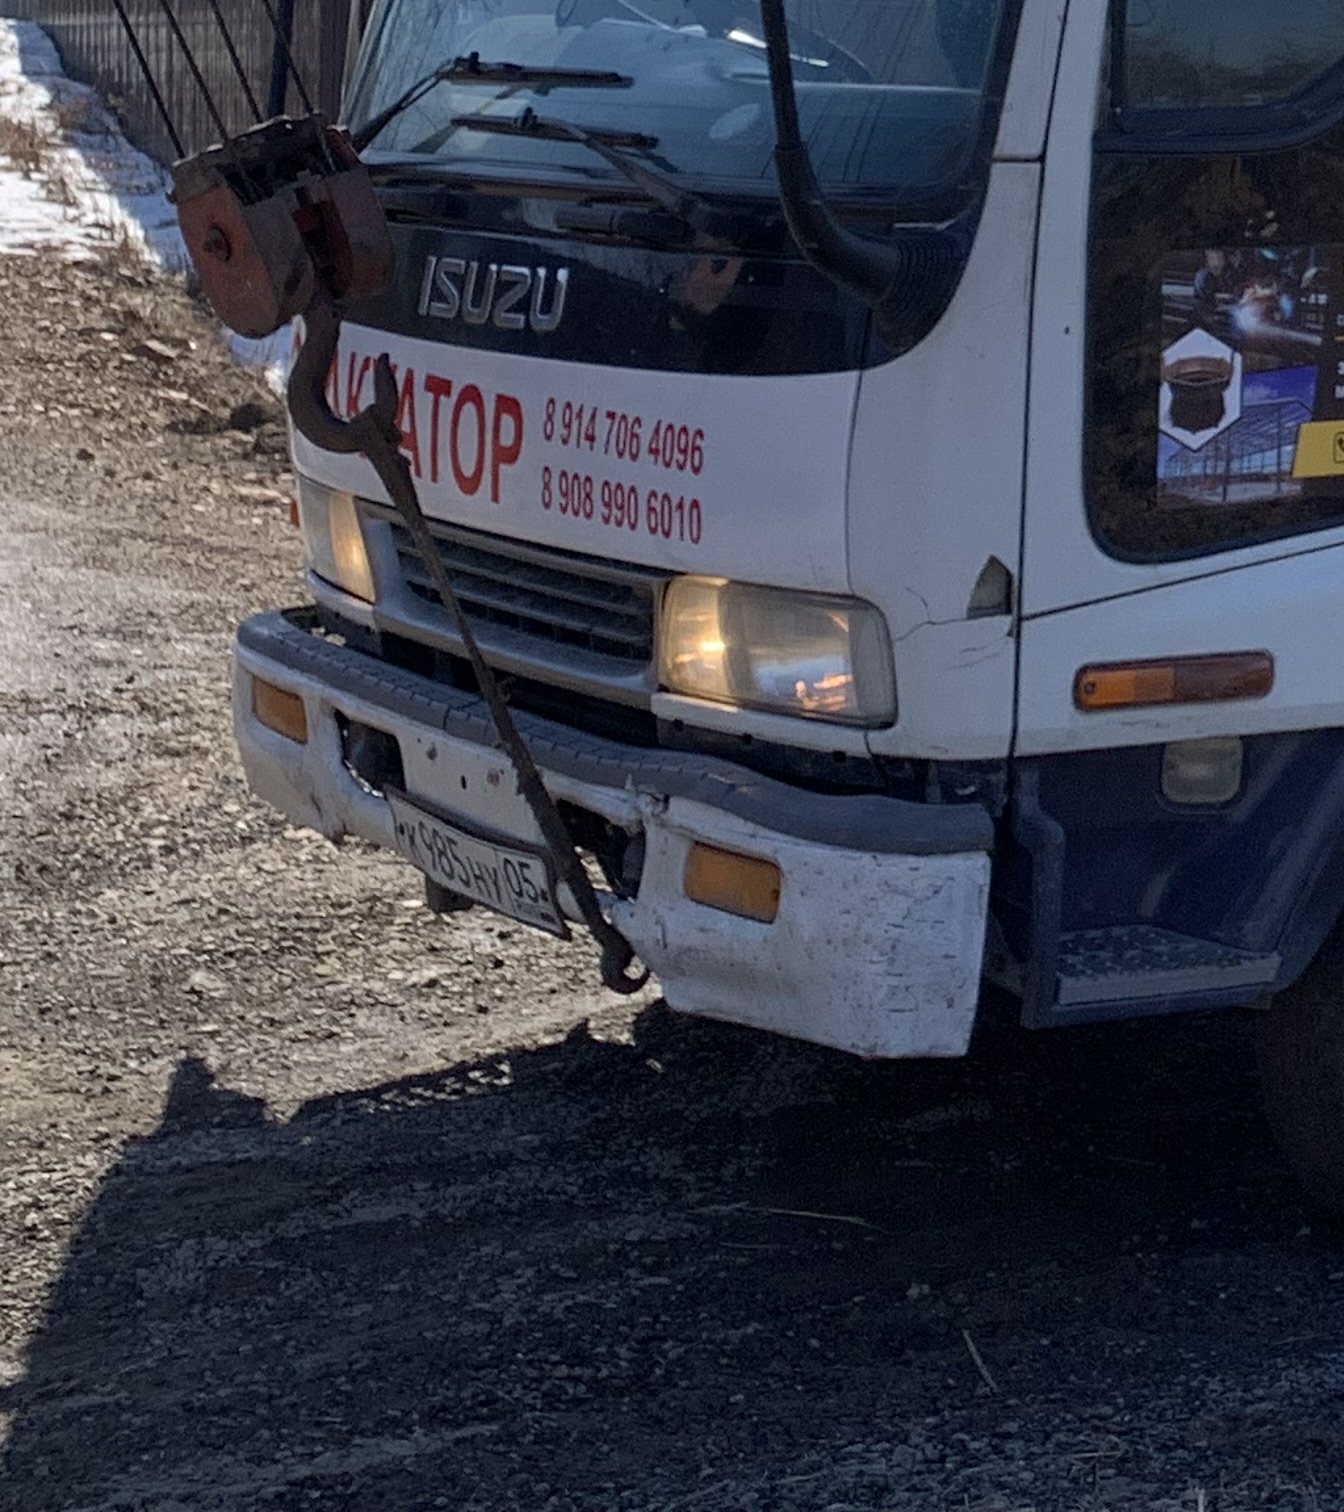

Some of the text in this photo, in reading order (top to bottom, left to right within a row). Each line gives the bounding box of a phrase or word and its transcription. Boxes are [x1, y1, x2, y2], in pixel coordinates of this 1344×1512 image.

[418, 256, 569, 332] ISUZU
[543, 397, 705, 476] 8 914 706 4096
[541, 466, 702, 545] 8 908 990 6010
